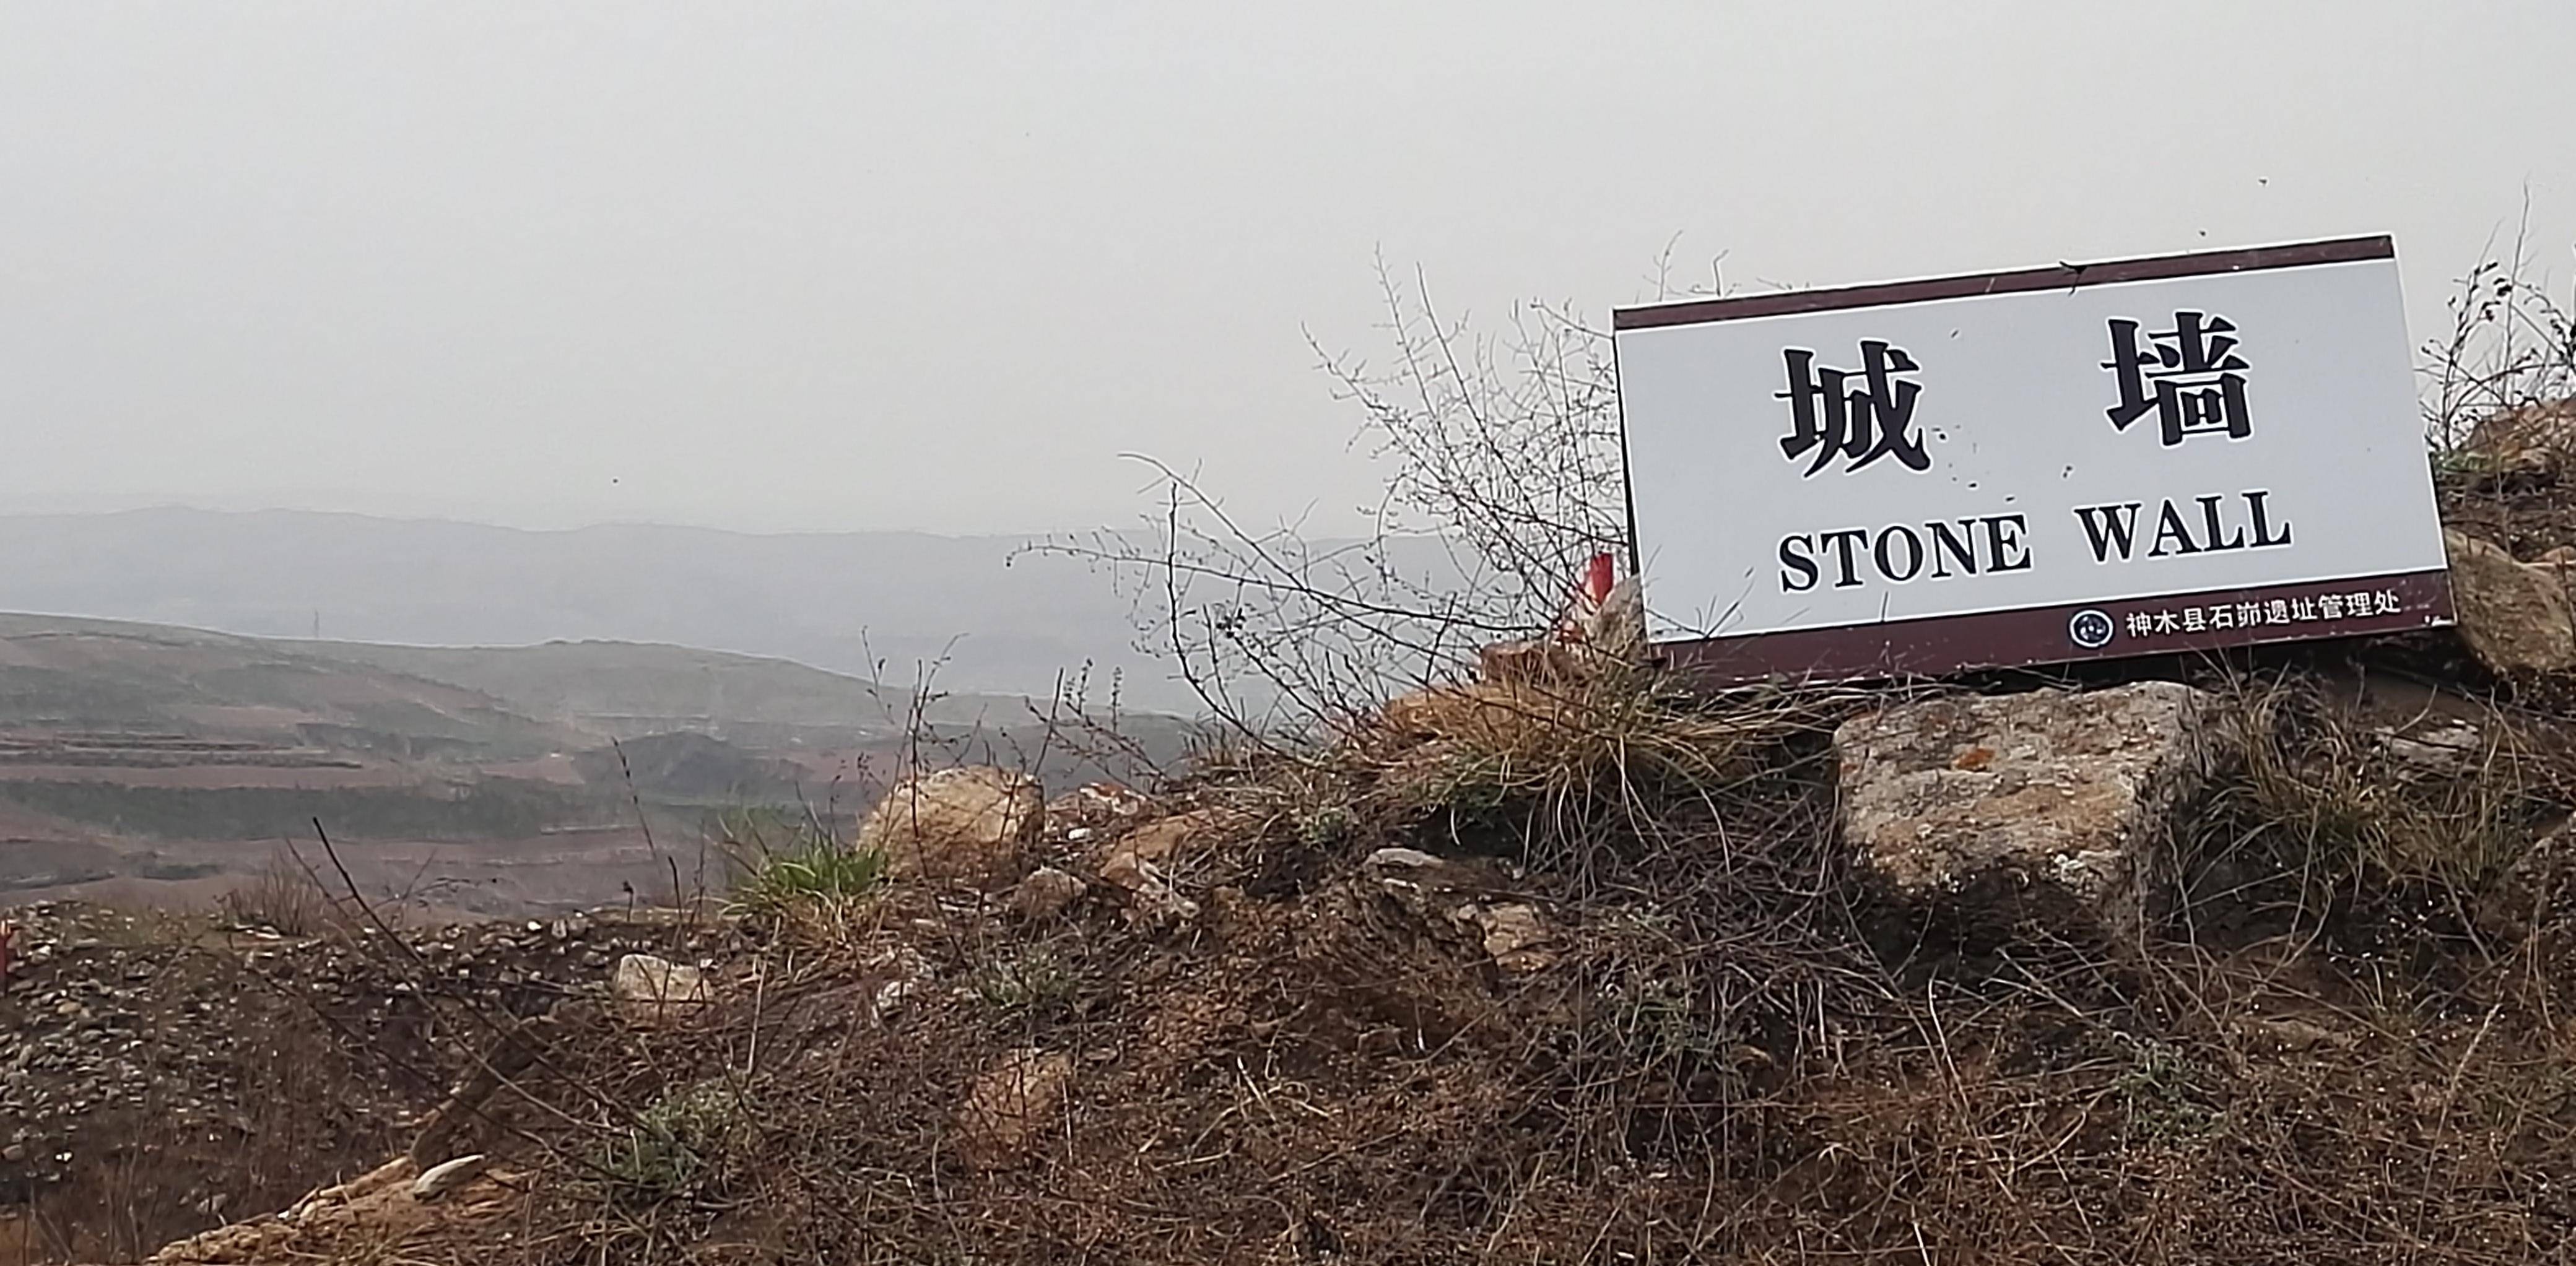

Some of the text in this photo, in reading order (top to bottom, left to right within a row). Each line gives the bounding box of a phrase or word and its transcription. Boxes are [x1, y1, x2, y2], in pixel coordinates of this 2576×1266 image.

[1779, 491, 2292, 592] STONE WALL
[2125, 589, 2402, 638] 神木县石峁遗址管理处
